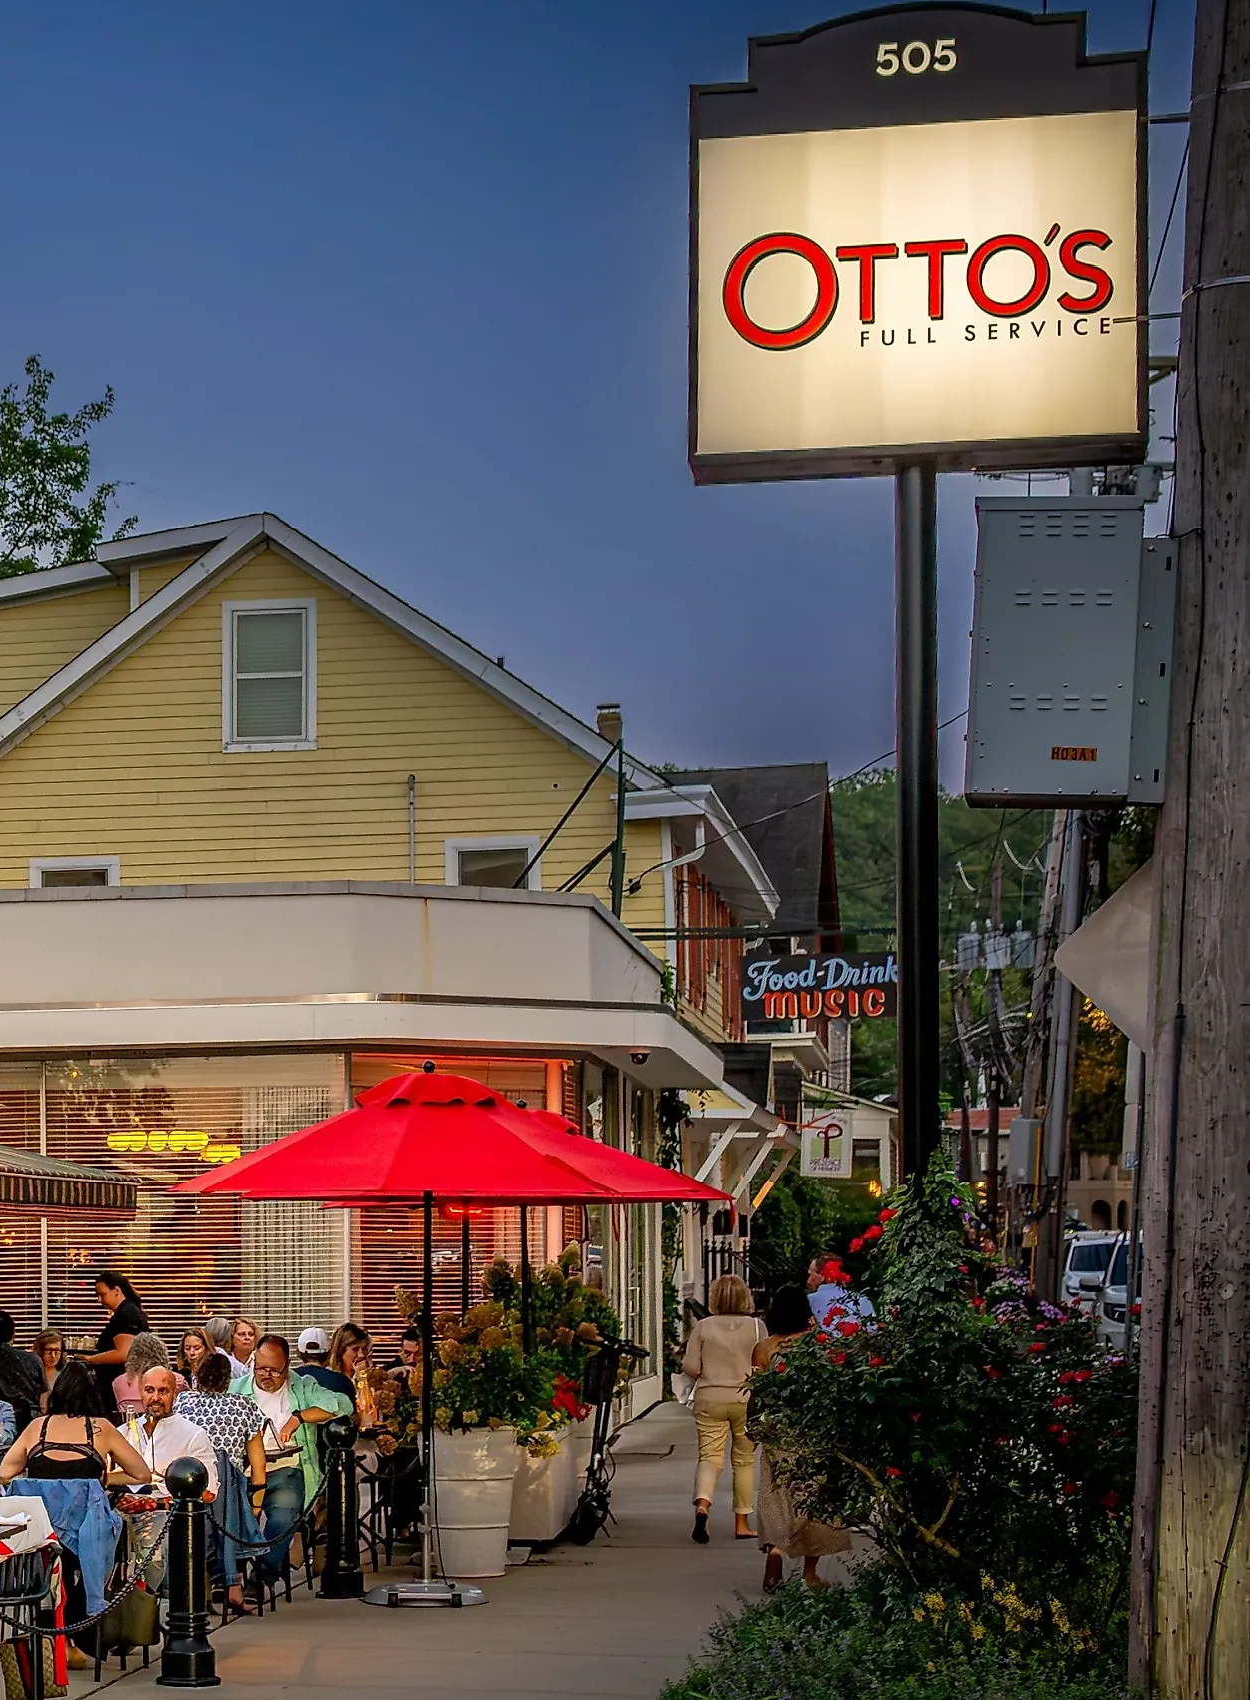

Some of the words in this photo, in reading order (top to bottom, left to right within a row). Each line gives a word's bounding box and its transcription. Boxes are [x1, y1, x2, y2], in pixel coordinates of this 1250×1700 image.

[875, 38, 958, 77] 505
[860, 326, 937, 348] FULL
[964, 316, 1112, 342] SERVICE
